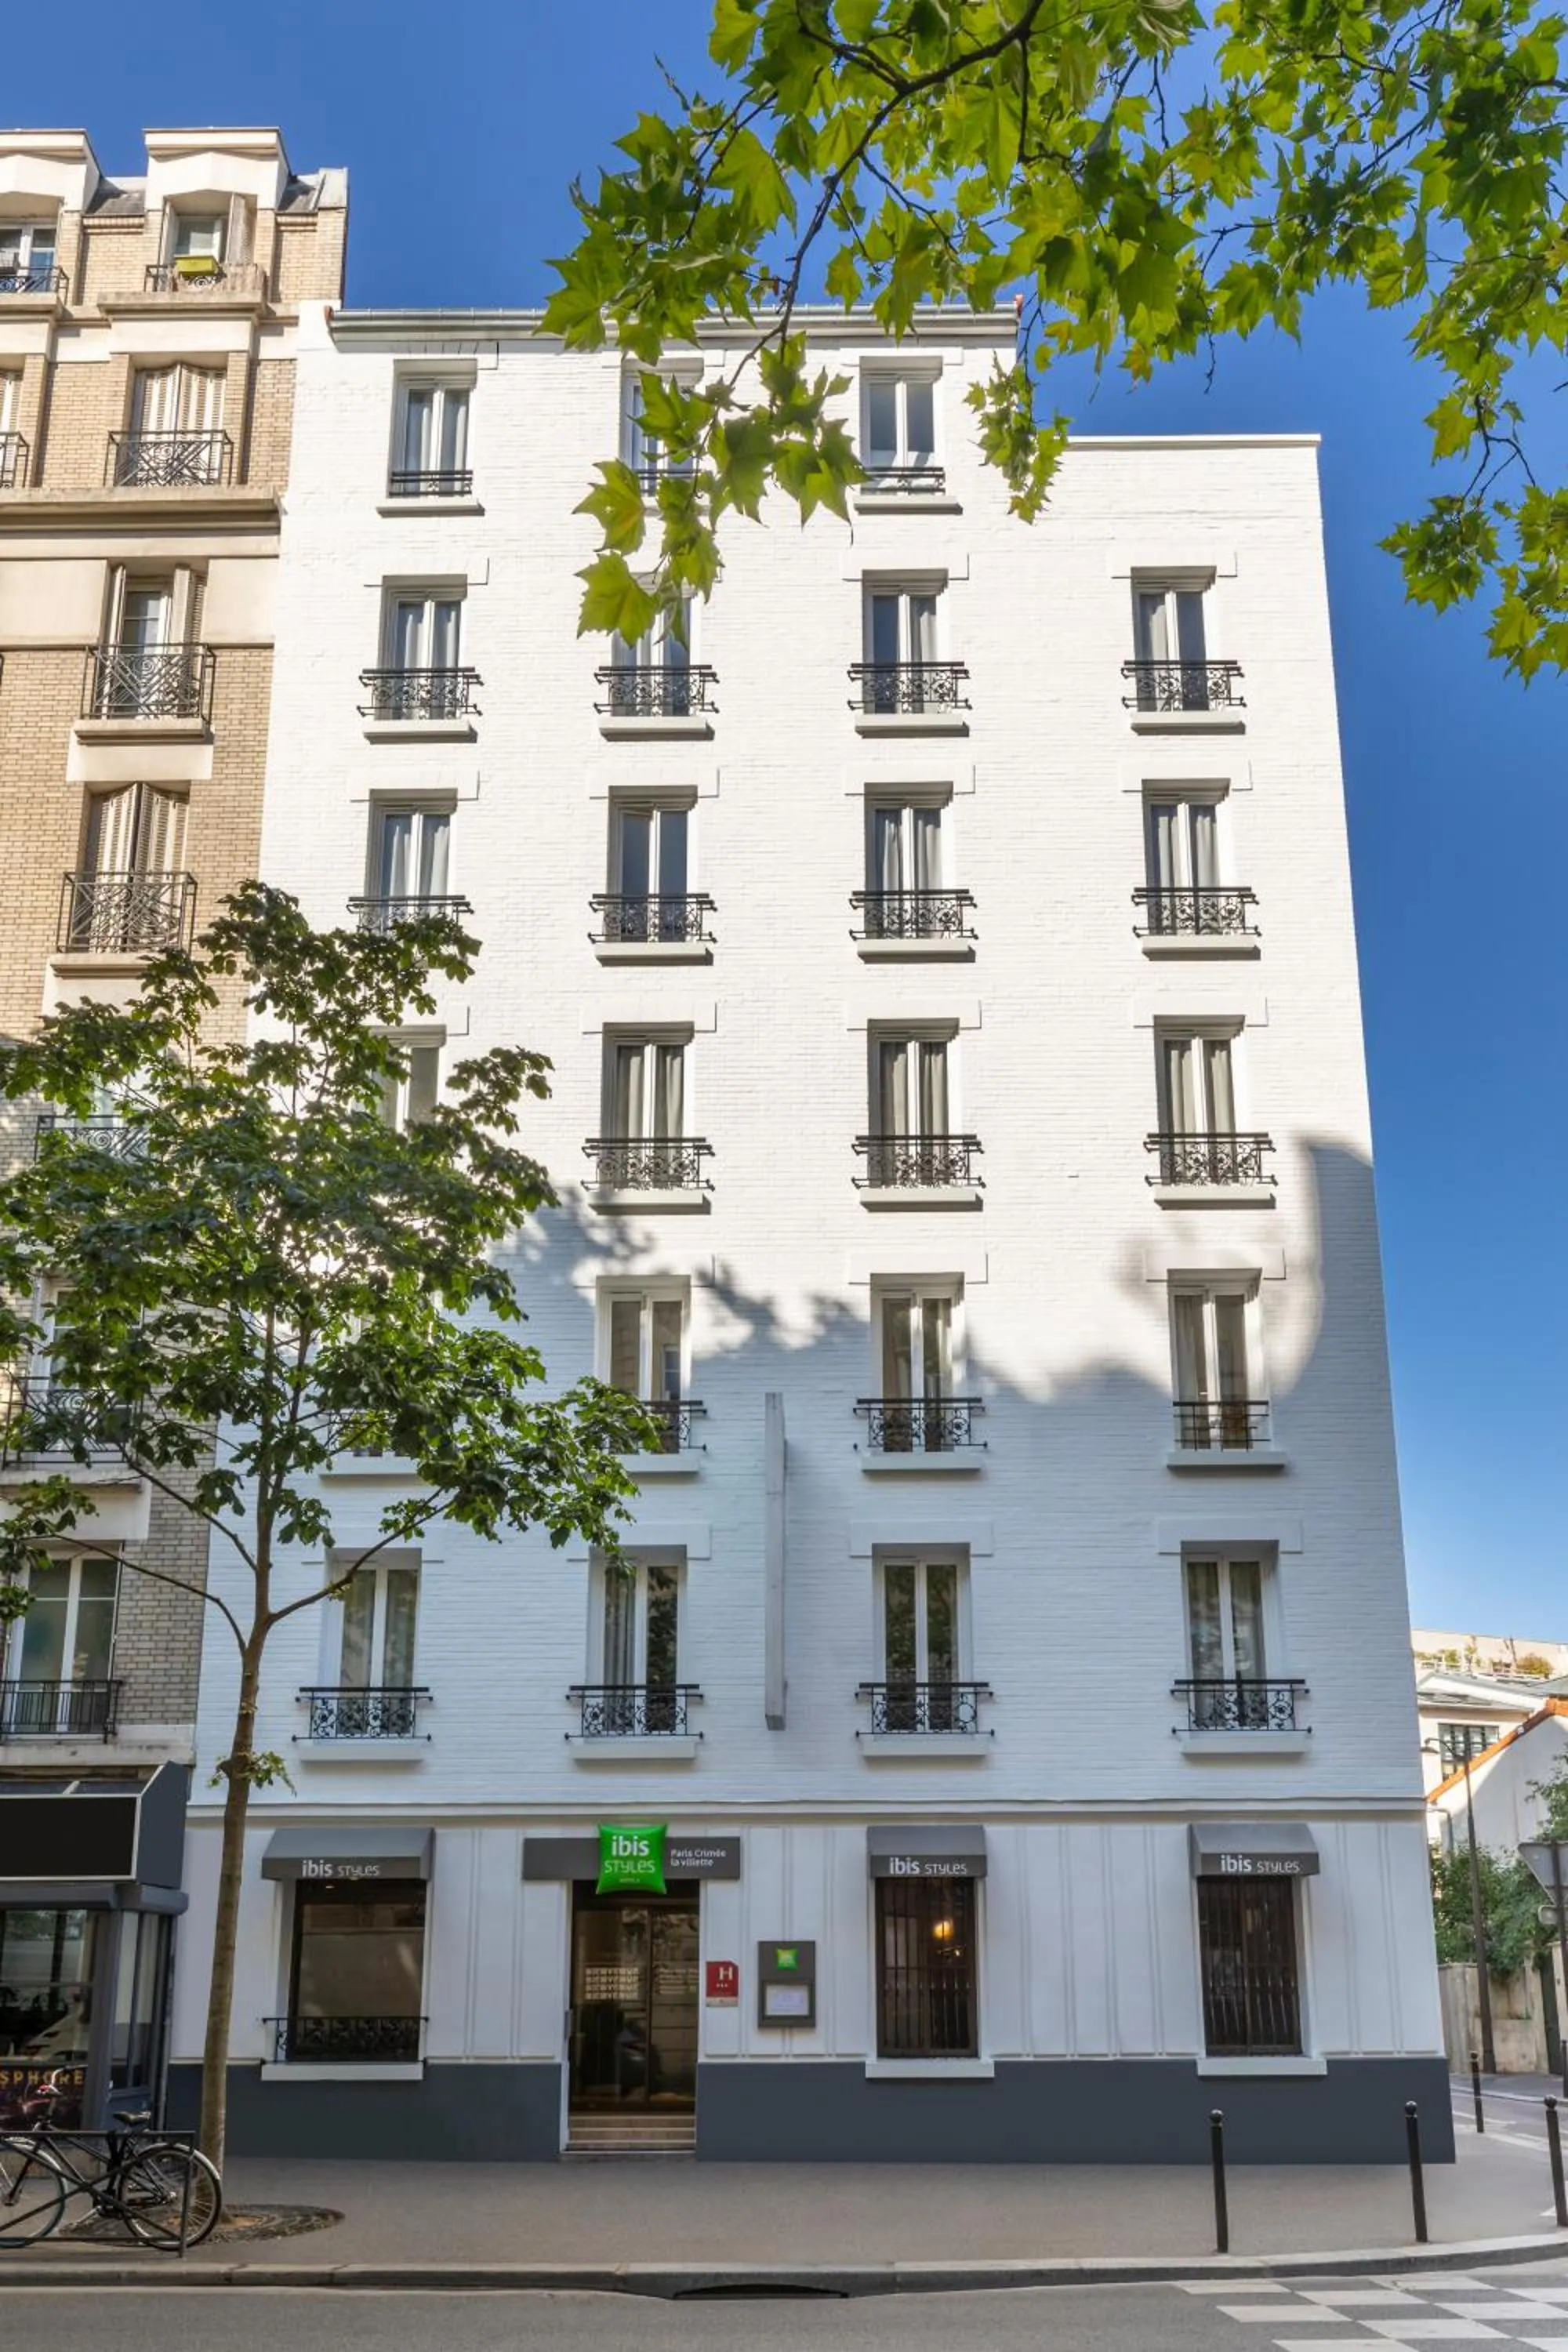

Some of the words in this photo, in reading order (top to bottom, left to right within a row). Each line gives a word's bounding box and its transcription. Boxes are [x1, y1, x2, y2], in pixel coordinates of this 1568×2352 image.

[611, 1835, 649, 1857] ibis
[670, 1849, 691, 1857] Paris
[694, 1849, 727, 1857] Crimée
[302, 1859, 333, 1878] ibis
[890, 1857, 920, 1875] ibis
[1221, 1854, 1252, 1873] ibis
[719, 1966, 733, 1980] H
